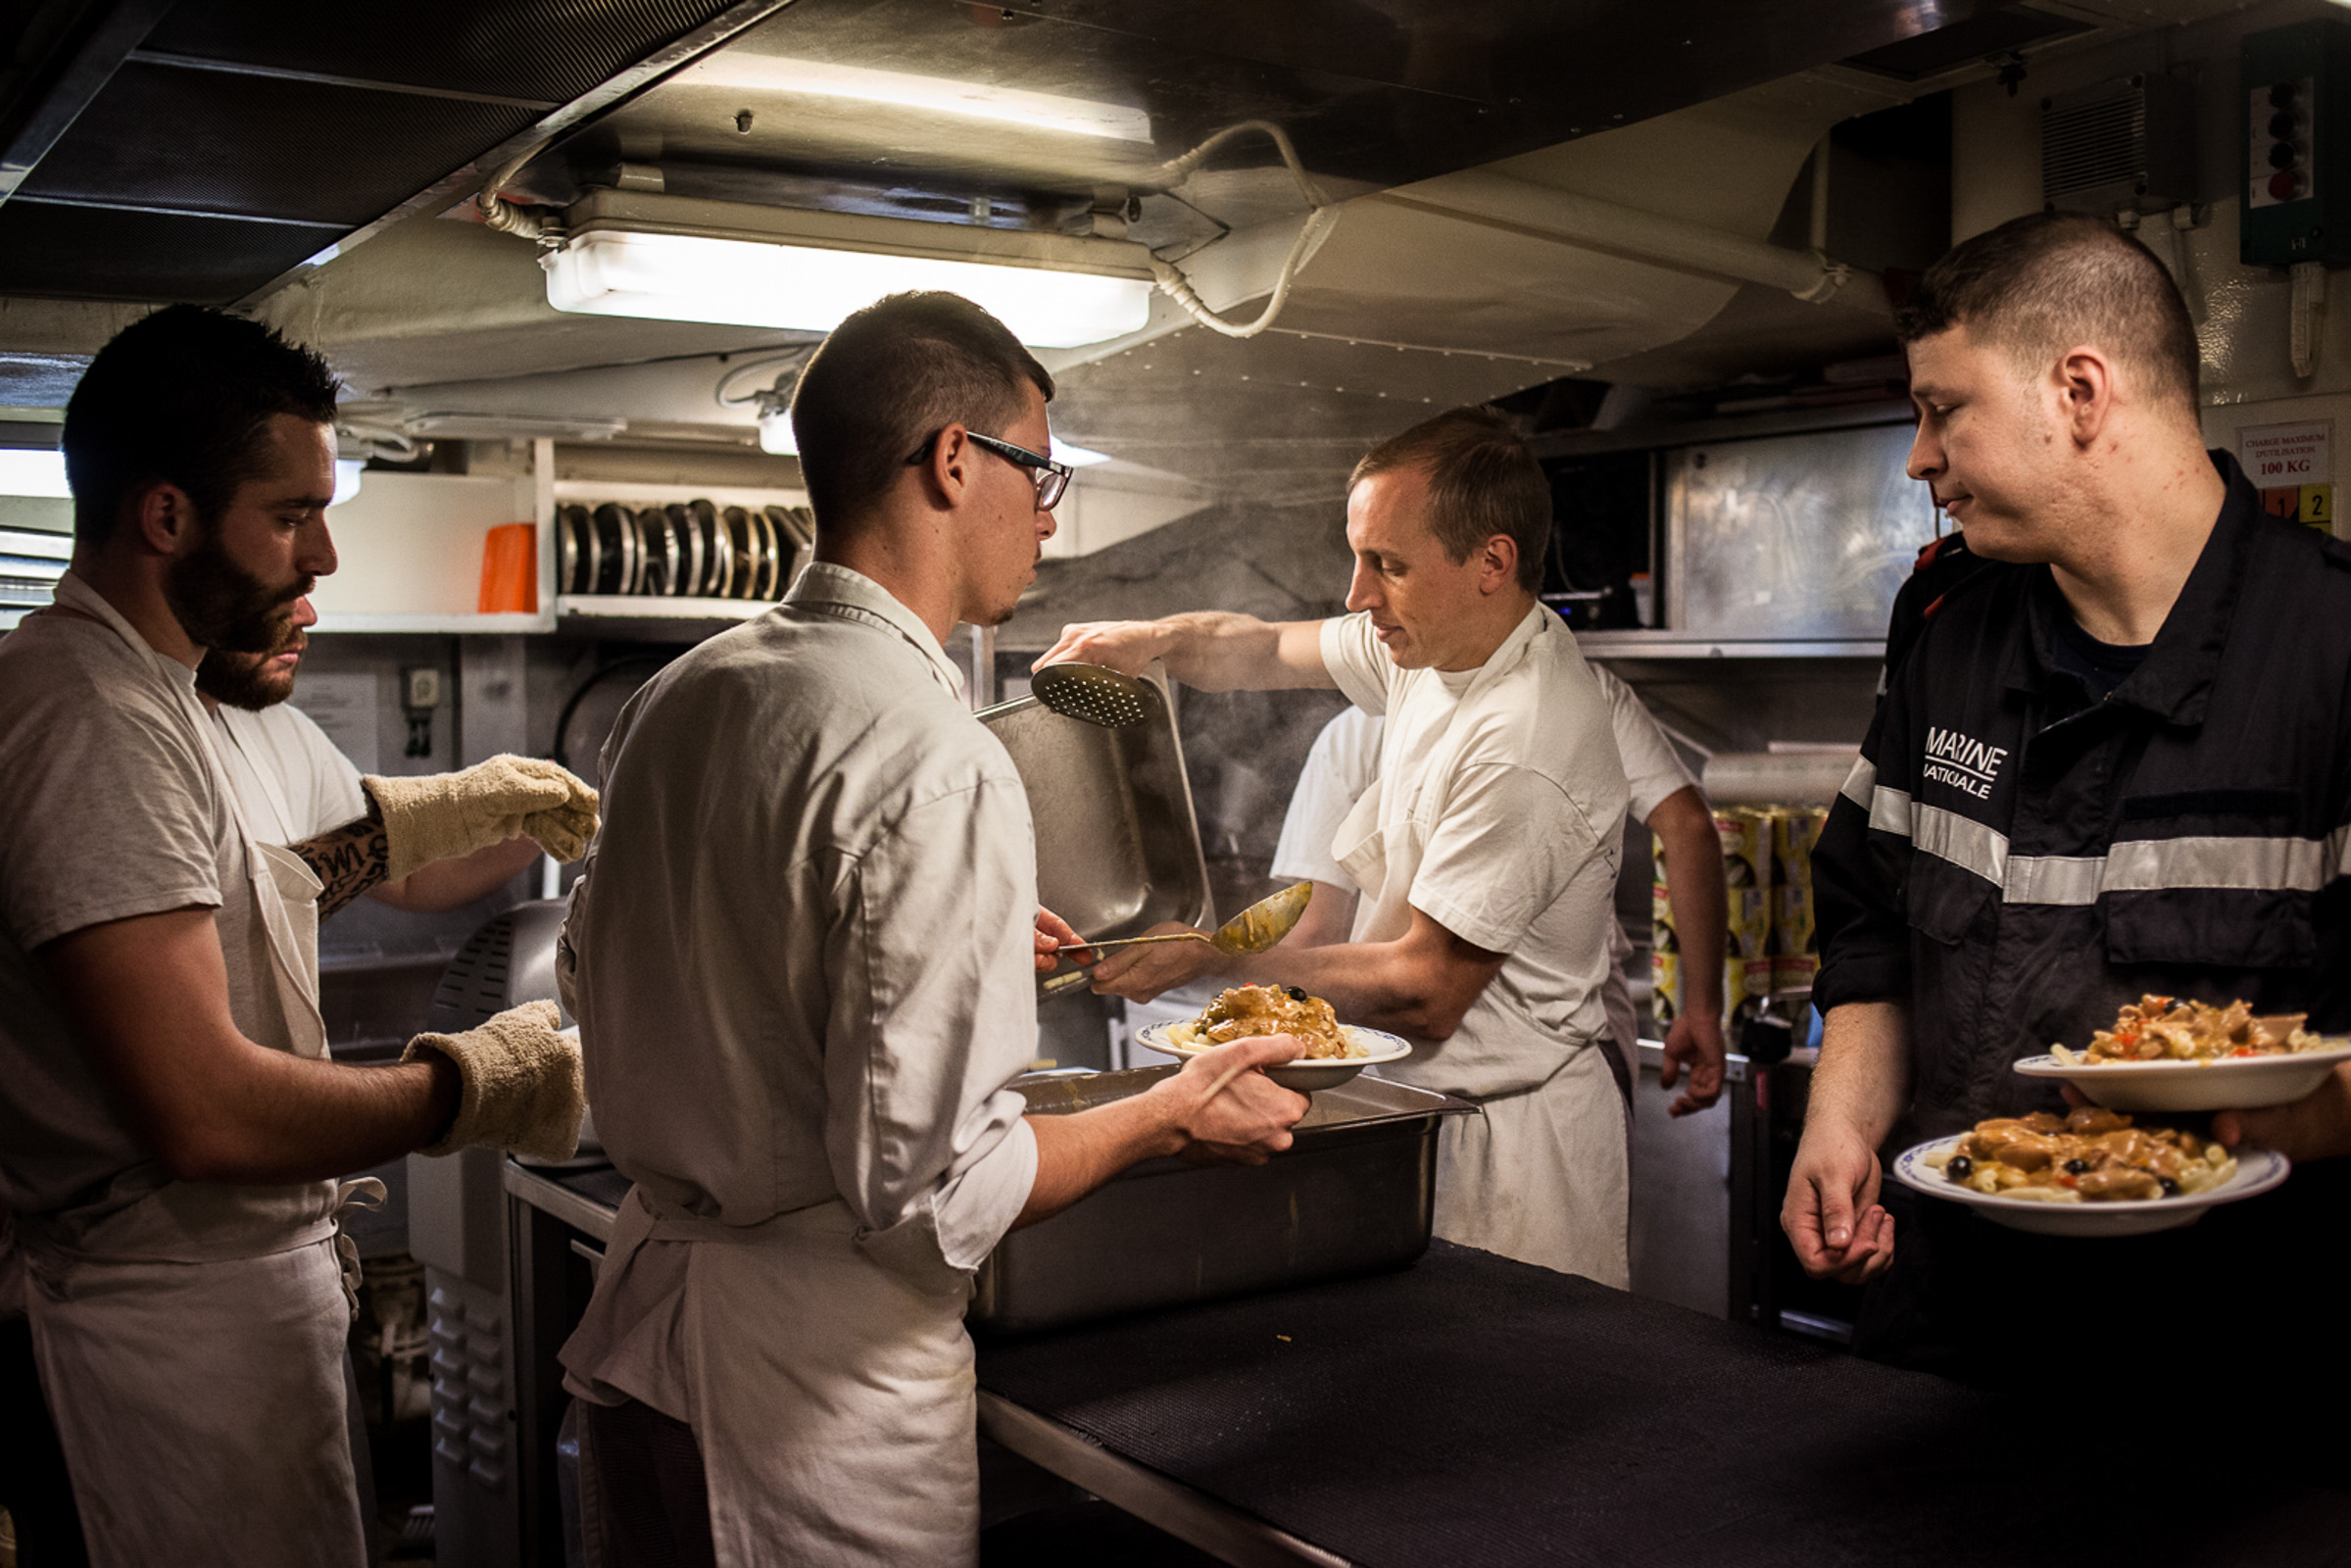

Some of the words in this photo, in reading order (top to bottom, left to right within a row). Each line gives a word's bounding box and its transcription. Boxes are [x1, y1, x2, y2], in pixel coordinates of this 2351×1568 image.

[2246, 437, 2279, 448] CHARGE
[2281, 433, 2326, 445] MAXIMUM
[2256, 446, 2316, 459] D'UTILISATION
[2261, 463, 2282, 475] 100
[2287, 460, 2311, 472] KG
[2312, 495, 2323, 515] 2
